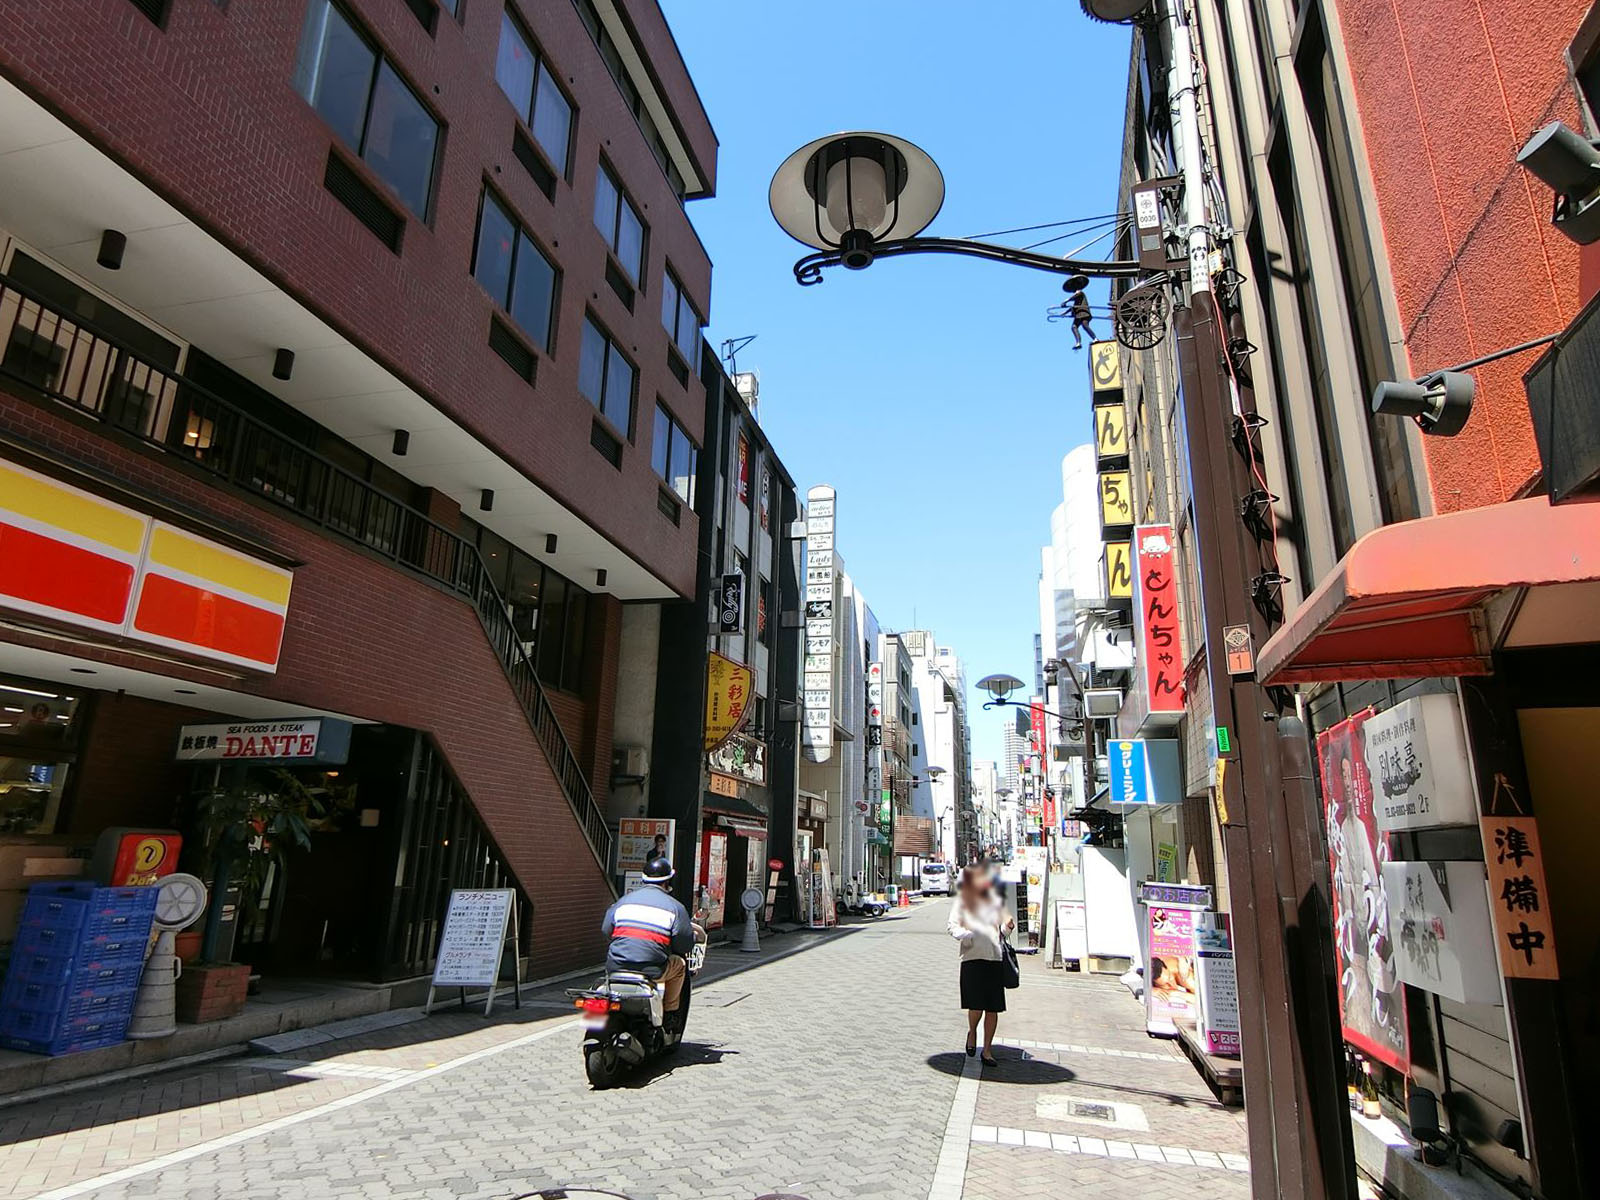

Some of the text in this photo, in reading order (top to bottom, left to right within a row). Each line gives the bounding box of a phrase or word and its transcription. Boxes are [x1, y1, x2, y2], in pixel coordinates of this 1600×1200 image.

[1145, 569, 1180, 697] とんちゃん
[1236, 654, 1242, 669] 1
[727, 667, 744, 719] 三彩居
[227, 725, 242, 734] SEA
[243, 724, 269, 733] FOODS
[279, 723, 304, 732] STEAK
[223, 734, 315, 758] DANTE
[1121, 751, 1137, 801] クリーニング
[1418, 793, 1429, 813] 2F
[459, 893, 504, 901] ランチメニュー
[1495, 826, 1545, 966] 準備中
